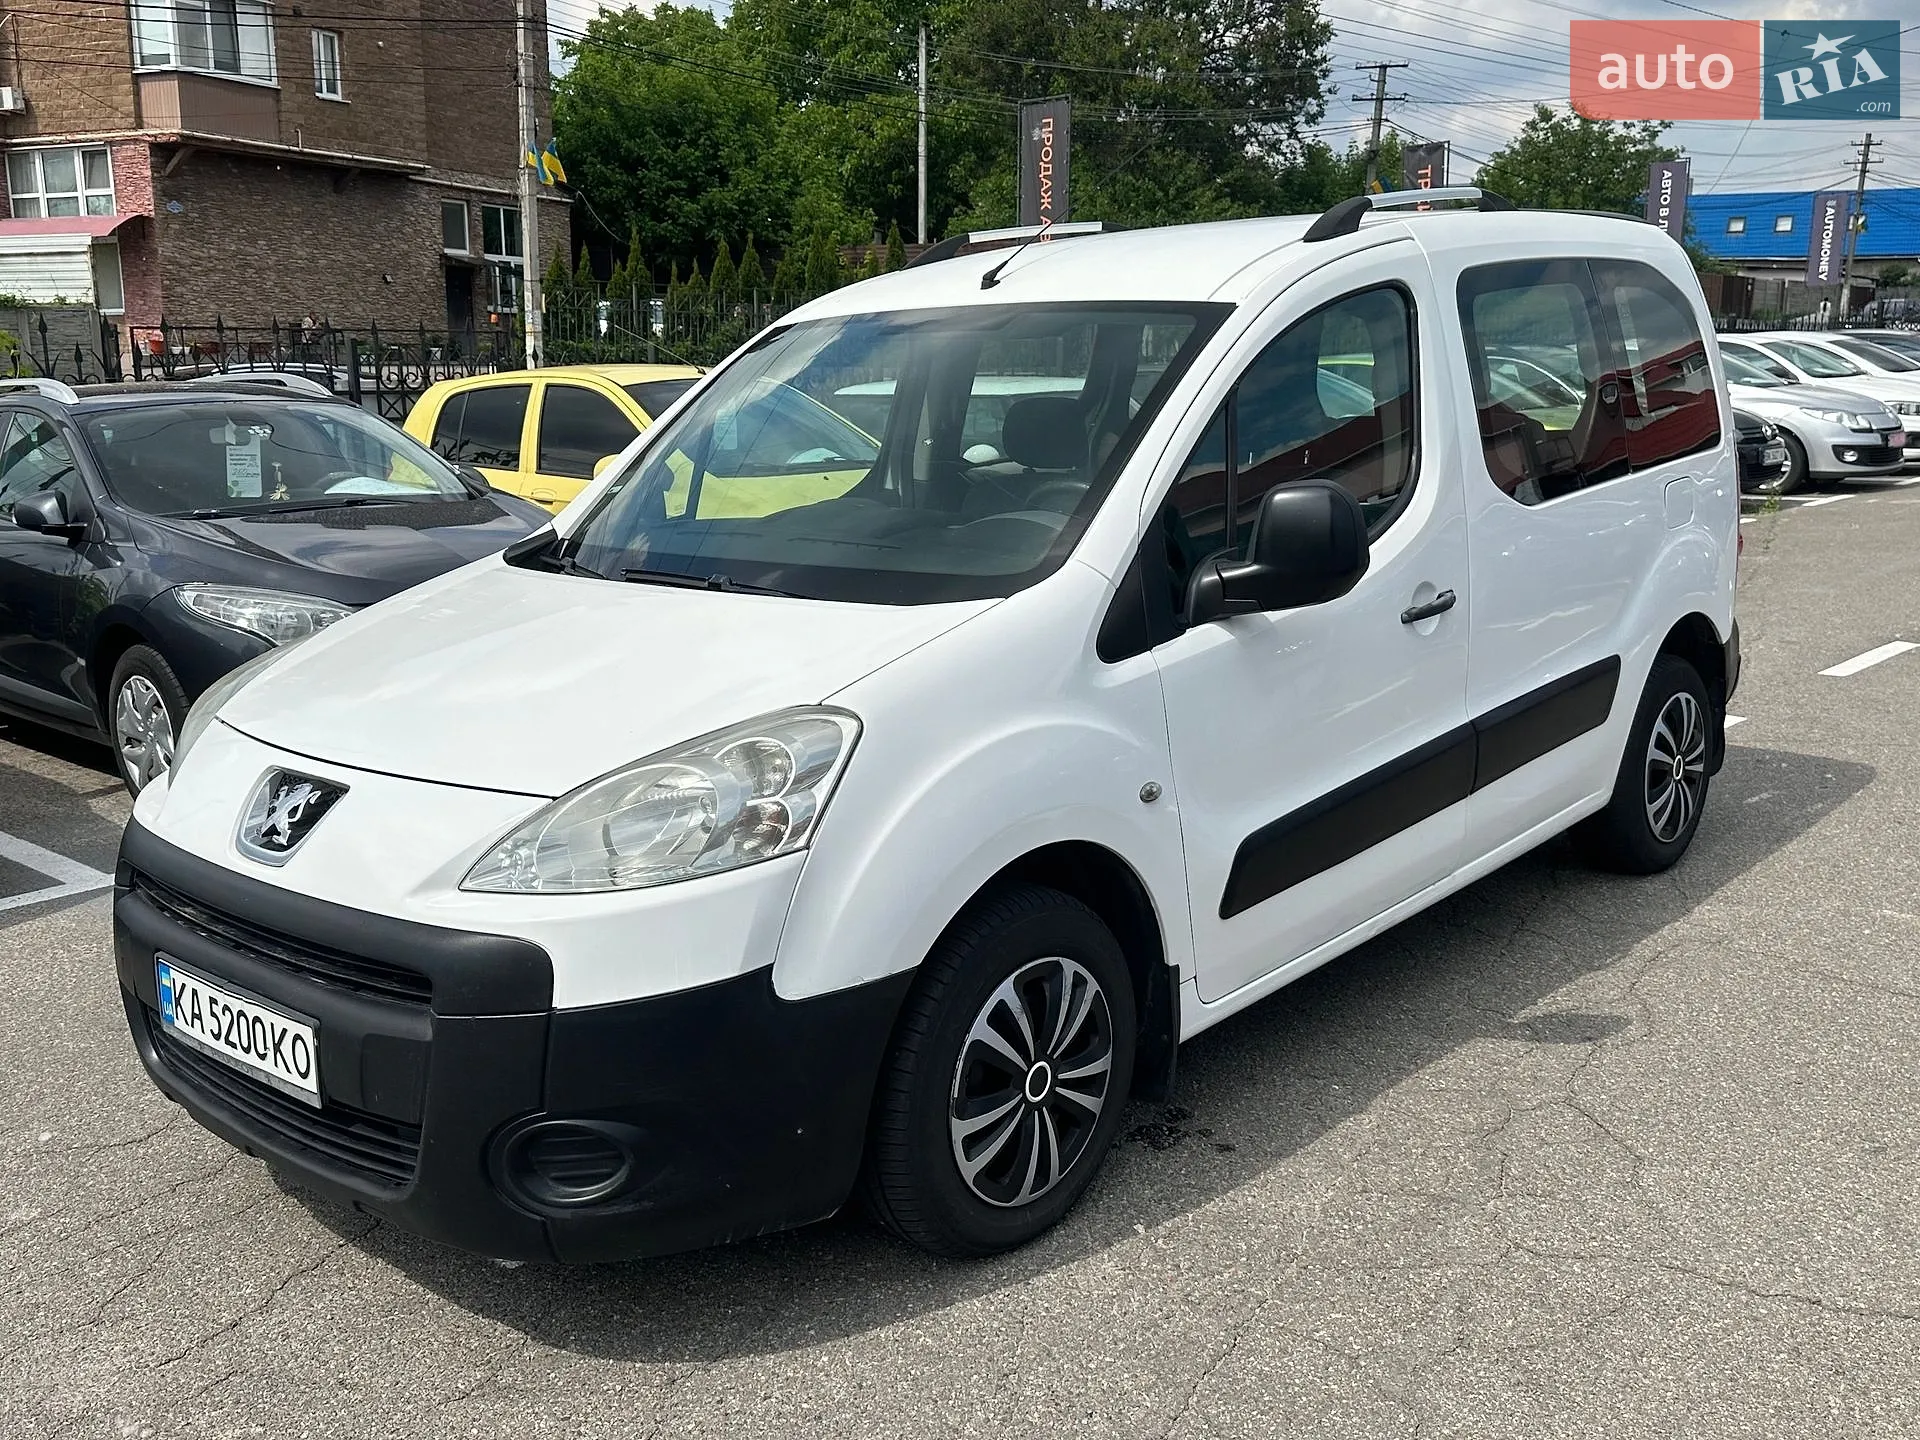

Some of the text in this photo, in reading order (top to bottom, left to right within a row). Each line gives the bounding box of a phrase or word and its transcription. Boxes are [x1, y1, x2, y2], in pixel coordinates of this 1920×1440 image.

[1039, 117, 1054, 210] ПРОДАЖ
[1659, 169, 1673, 206] АВТО
[1659, 207, 1670, 217] В
[1818, 206, 1836, 281] AUTOMONEY
